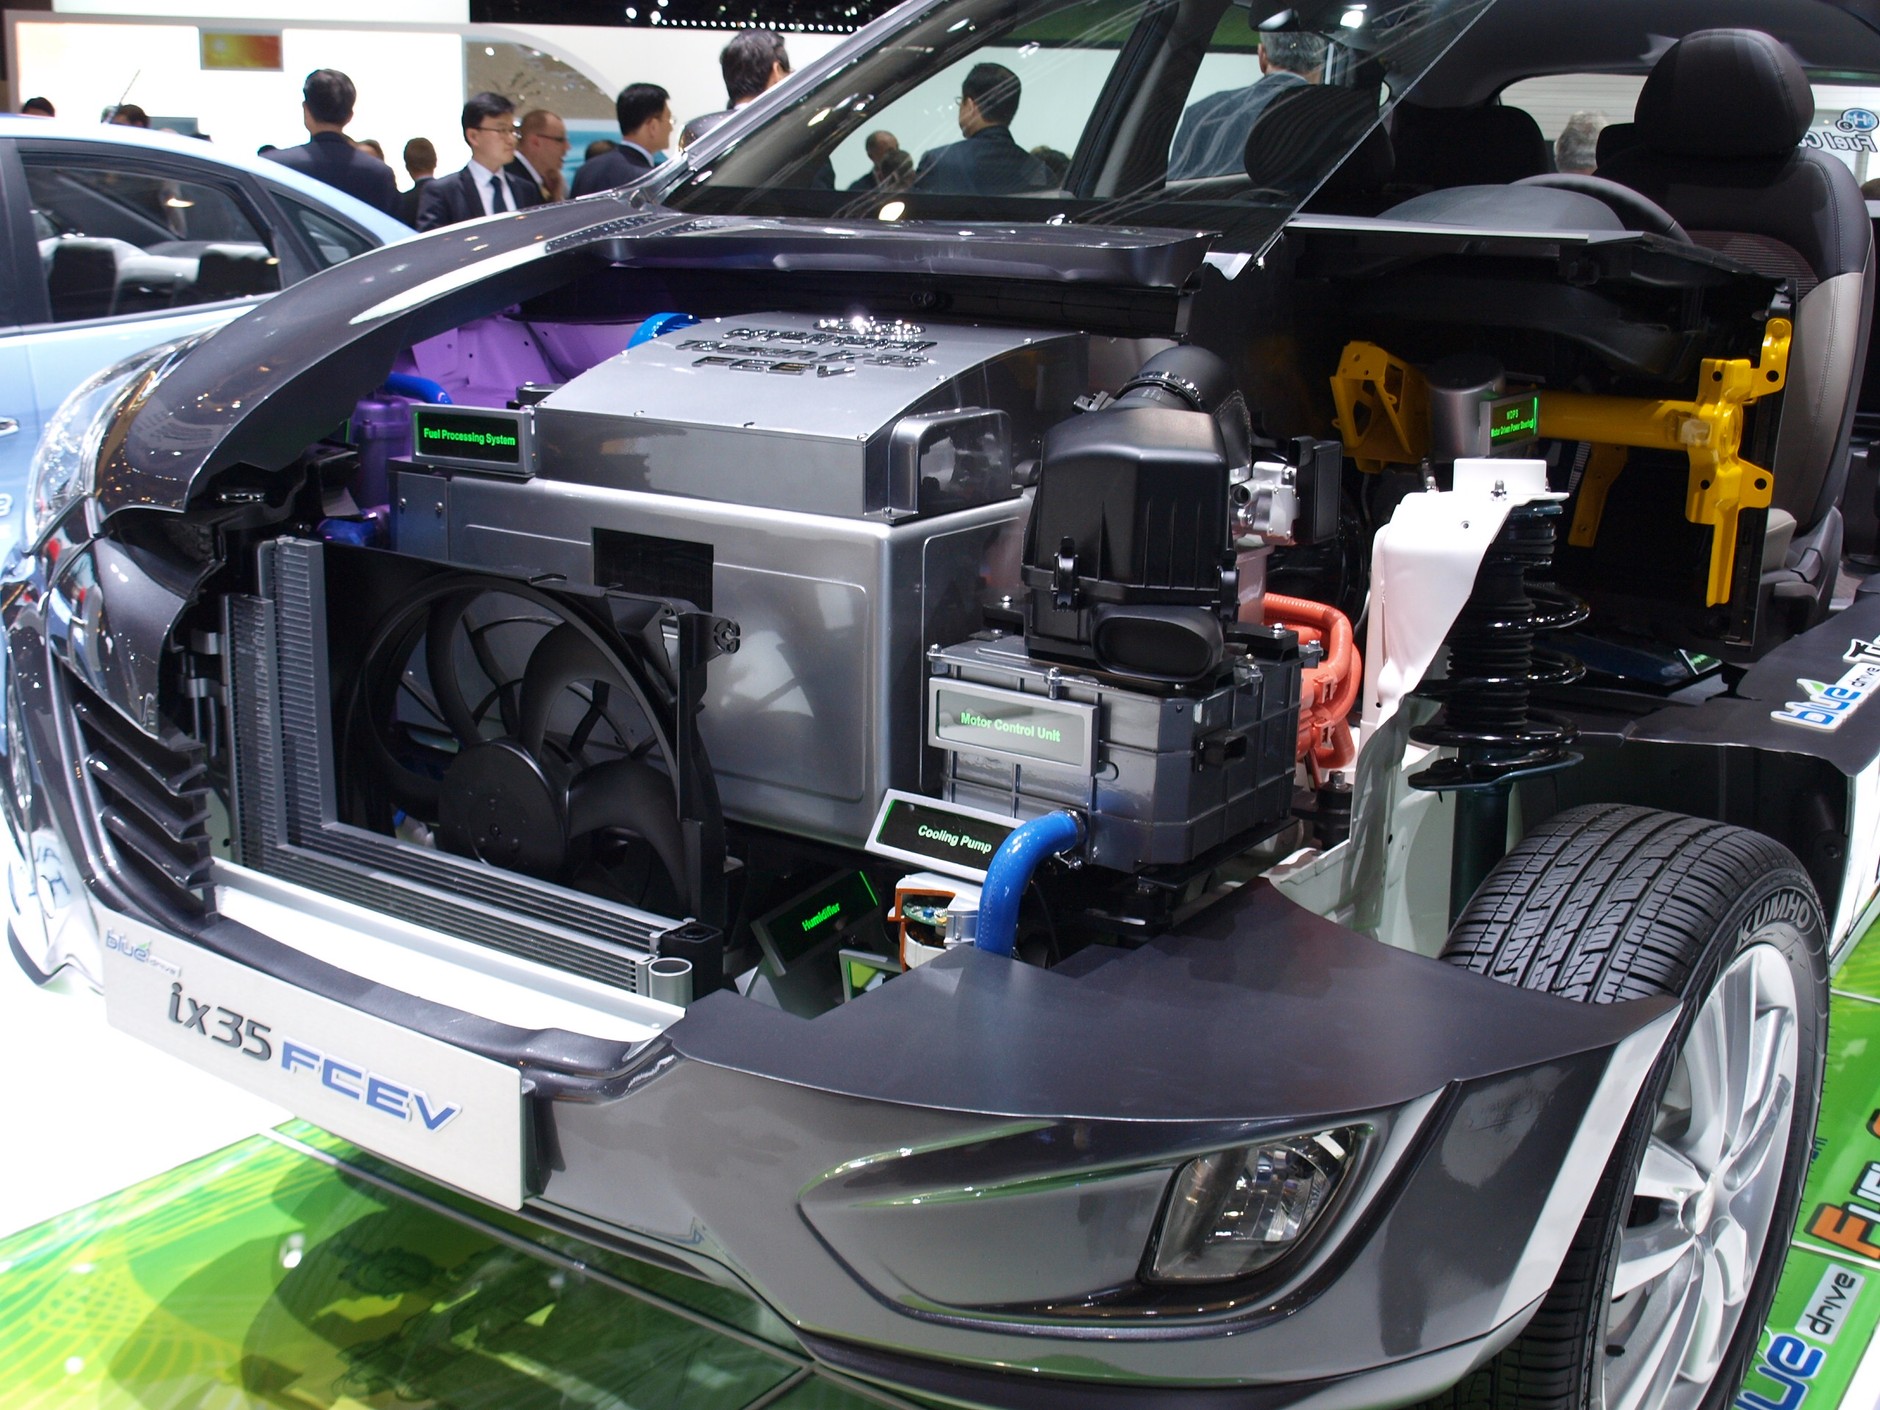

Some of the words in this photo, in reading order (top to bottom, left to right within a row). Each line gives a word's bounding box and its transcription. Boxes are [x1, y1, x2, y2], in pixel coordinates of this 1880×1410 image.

[691, 355, 857, 378] FCEV
[423, 427, 441, 440] Fuel
[441, 429, 485, 445] Processing
[485, 432, 516, 446] System
[1778, 686, 1862, 726] blue
[960, 711, 993, 730] Motor
[993, 718, 1035, 738] Control
[1037, 727, 1062, 743] Unit
[918, 824, 960, 847] Cooling
[959, 834, 993, 855] Pump
[801, 902, 841, 932] Humidifier
[1735, 889, 1811, 952] KUMHO
[106, 929, 149, 964] blue
[167, 982, 273, 1062] ix35
[280, 1038, 460, 1132] FCEV
[1805, 1271, 1857, 1336] drive
